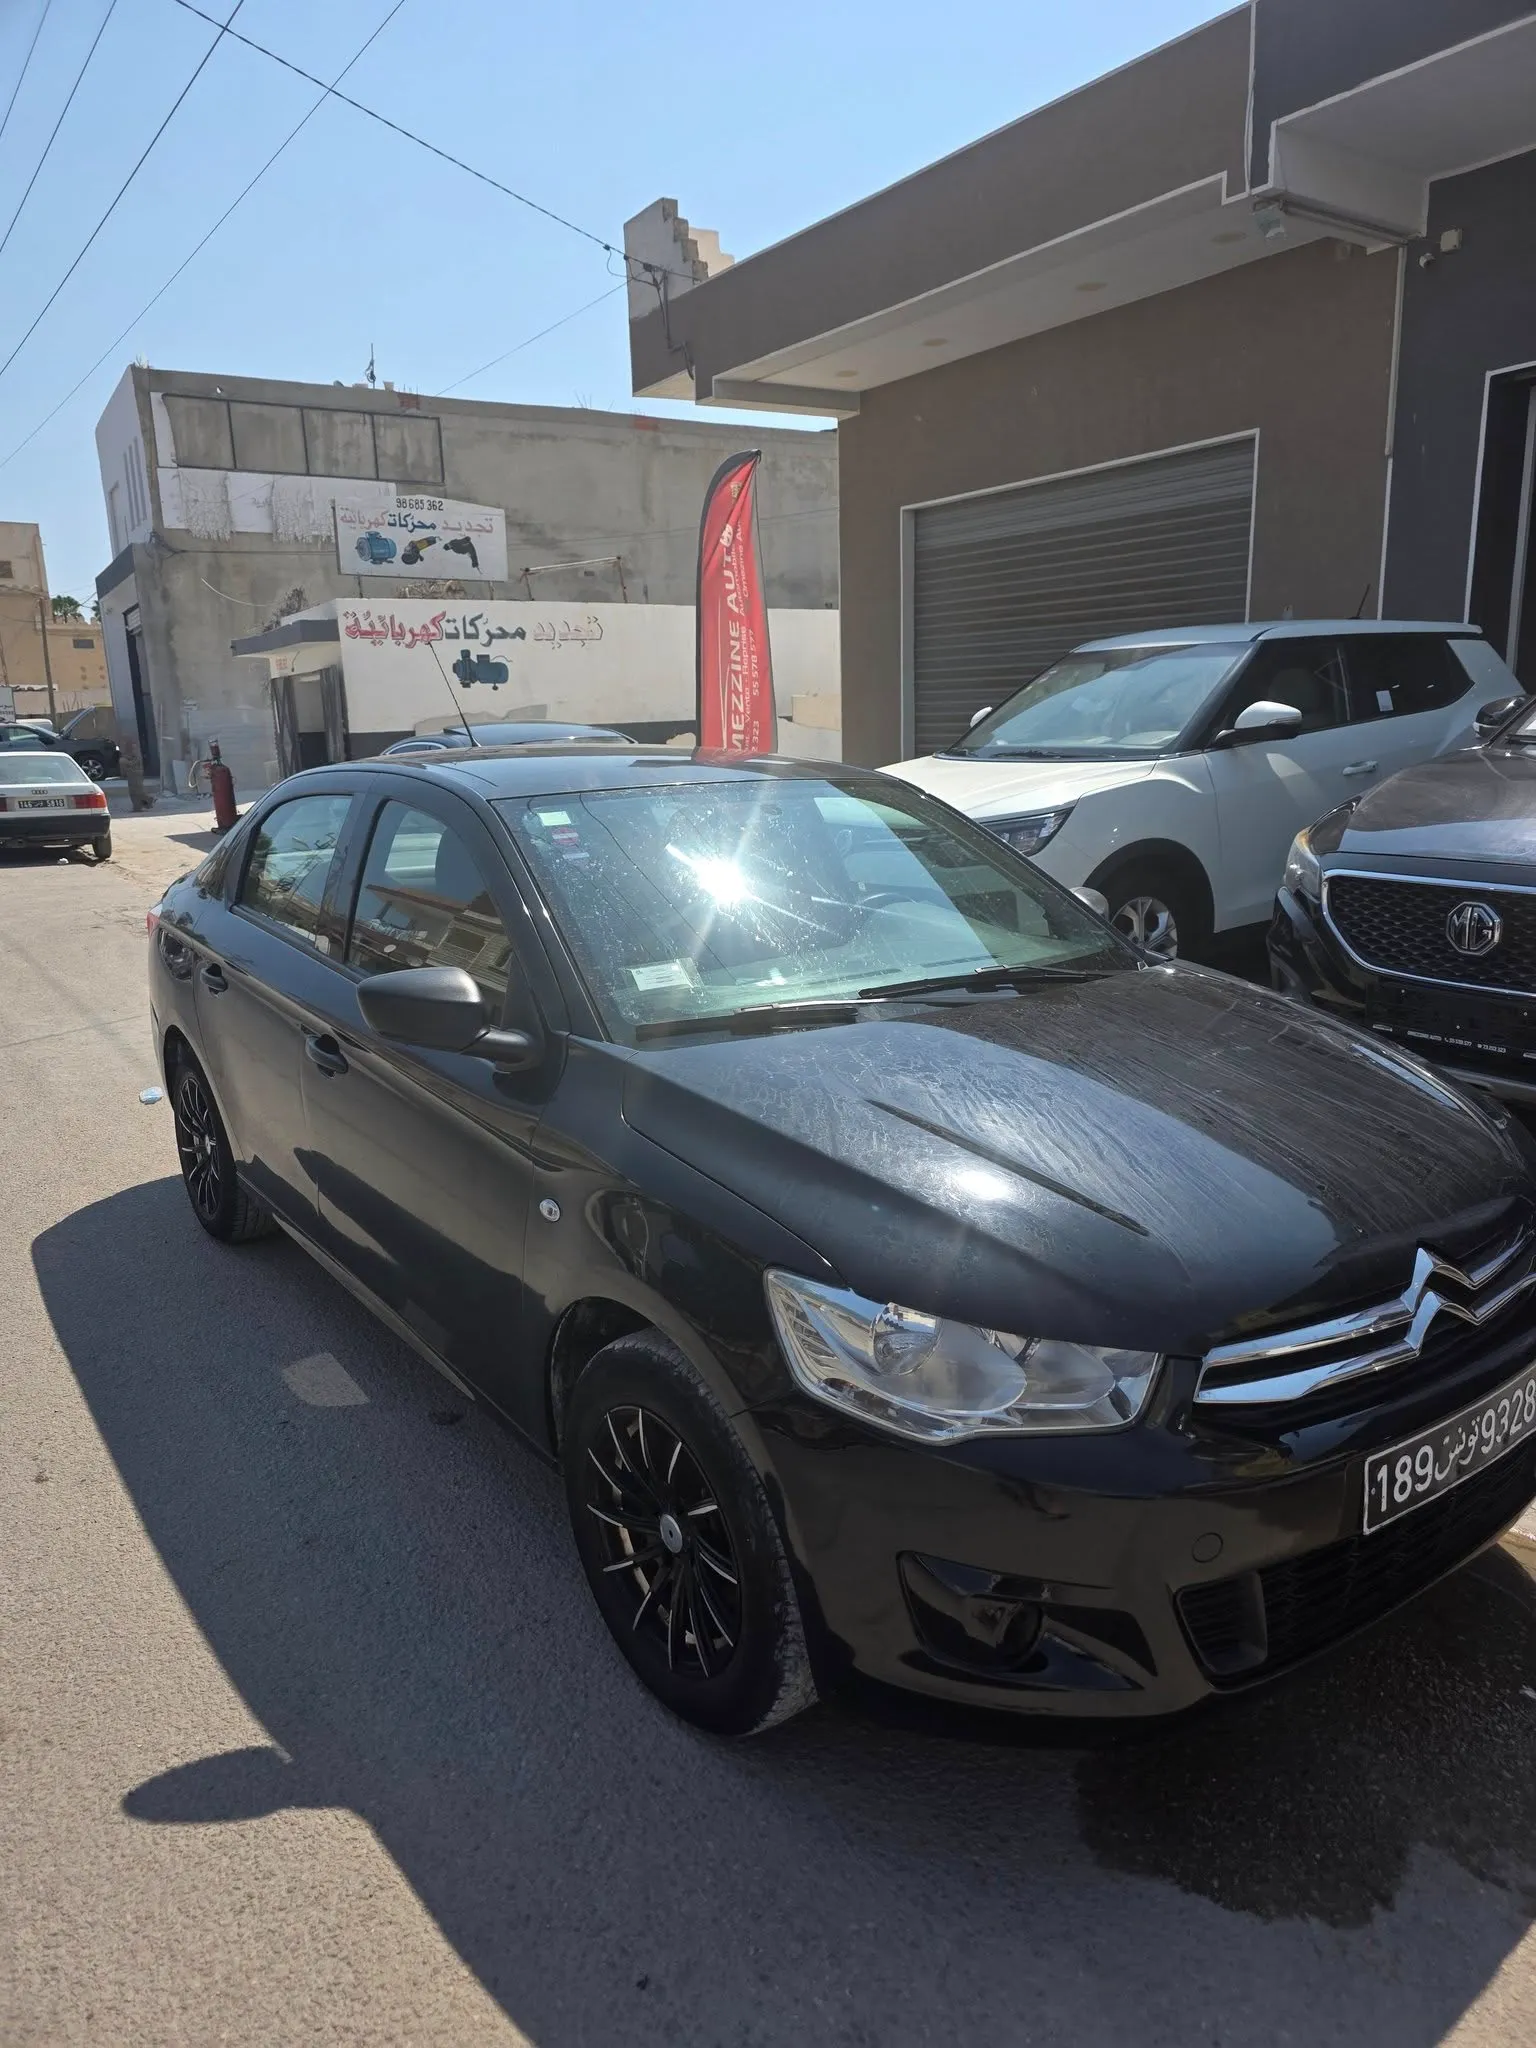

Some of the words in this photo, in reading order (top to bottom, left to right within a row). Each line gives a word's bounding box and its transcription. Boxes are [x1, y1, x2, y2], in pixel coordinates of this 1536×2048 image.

[533, 616, 603, 650] تجديد
[1451, 906, 1494, 951] MG
[1377, 1445, 1434, 1512] 189
[1434, 1415, 1480, 1481] تونس
[1481, 1378, 1536, 1454] 9328
